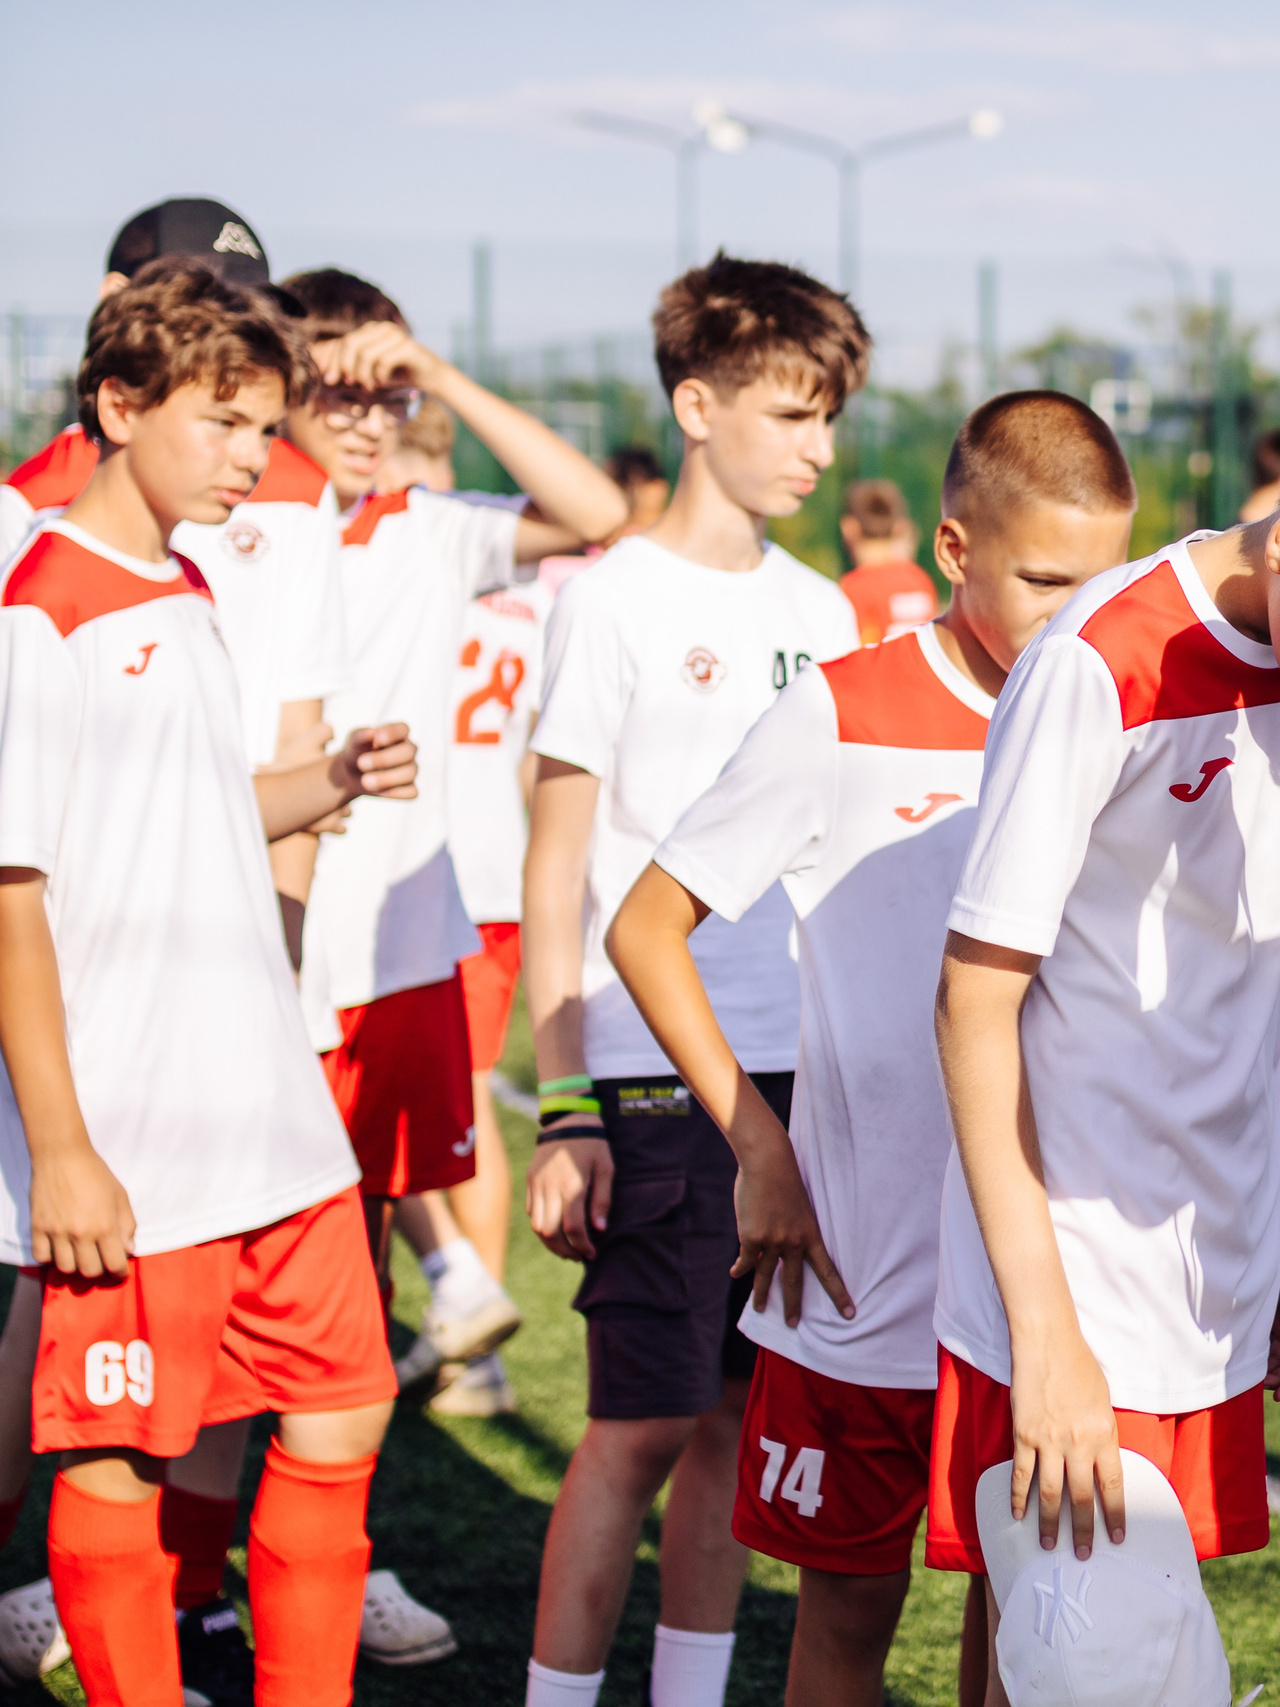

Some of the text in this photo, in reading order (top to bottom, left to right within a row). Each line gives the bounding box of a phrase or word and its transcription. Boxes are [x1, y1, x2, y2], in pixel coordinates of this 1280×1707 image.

[85, 1339, 155, 1407] 69
[759, 1435, 826, 1518] 74
[1033, 1566, 1095, 1649] NY
